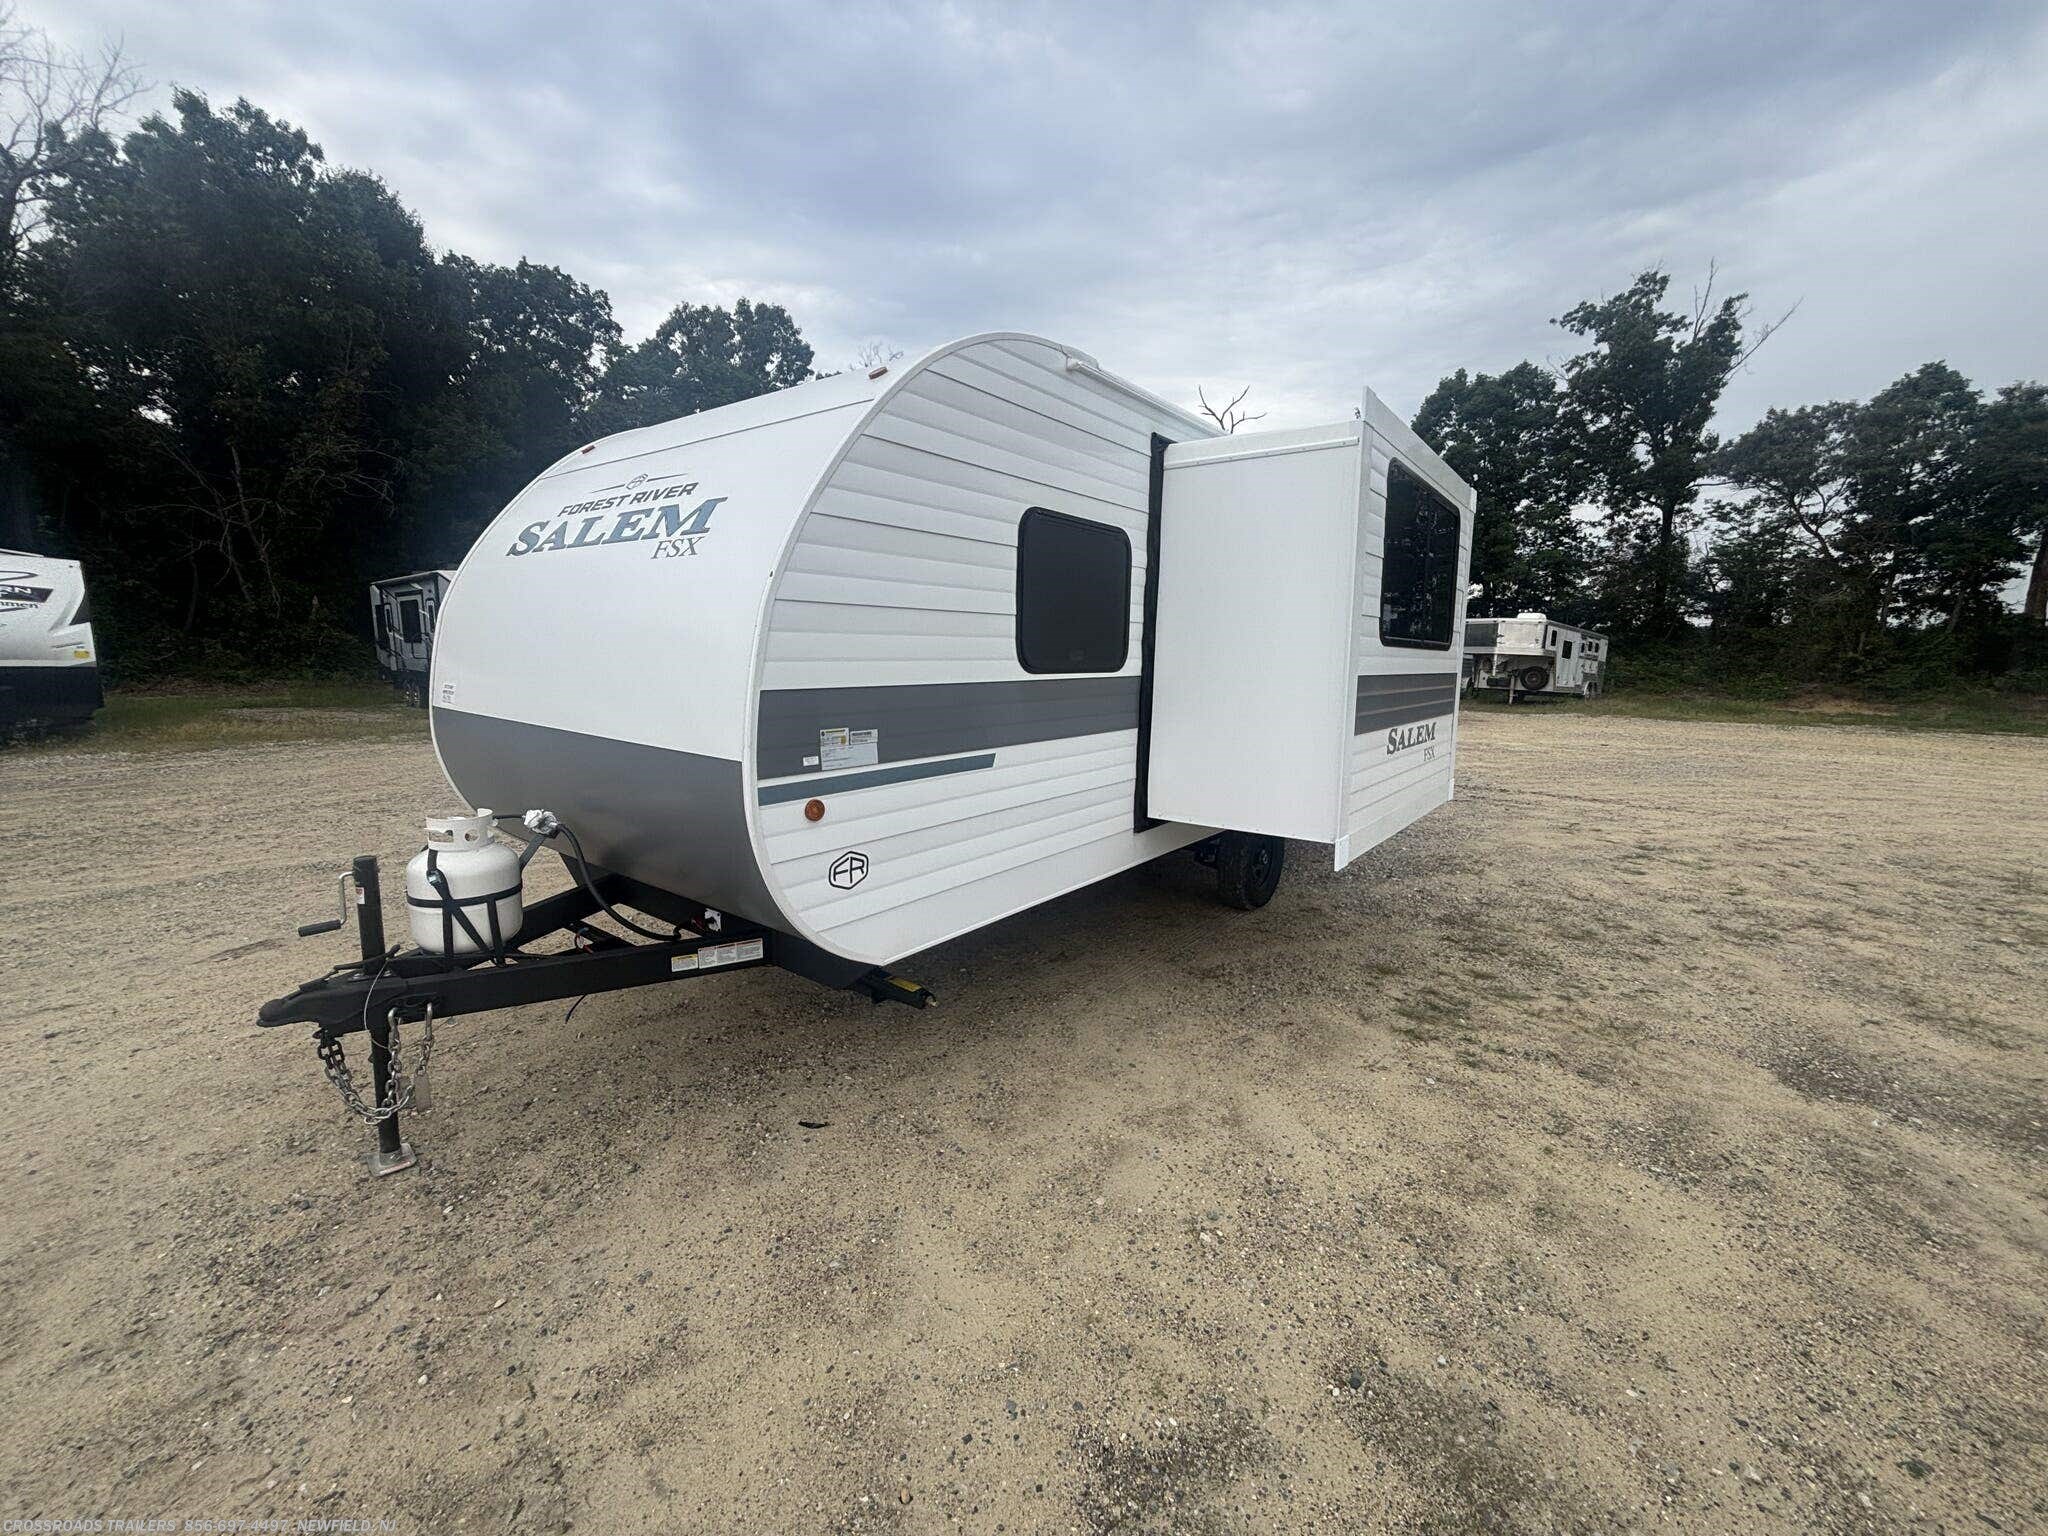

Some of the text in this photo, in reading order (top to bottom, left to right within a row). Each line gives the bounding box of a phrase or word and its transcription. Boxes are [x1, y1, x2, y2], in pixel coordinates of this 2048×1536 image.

[557, 482, 699, 517] FOREST RIVER
[505, 496, 728, 557] SALEM
[651, 536, 706, 559] FSX
[1386, 721, 1437, 755] SALEM
